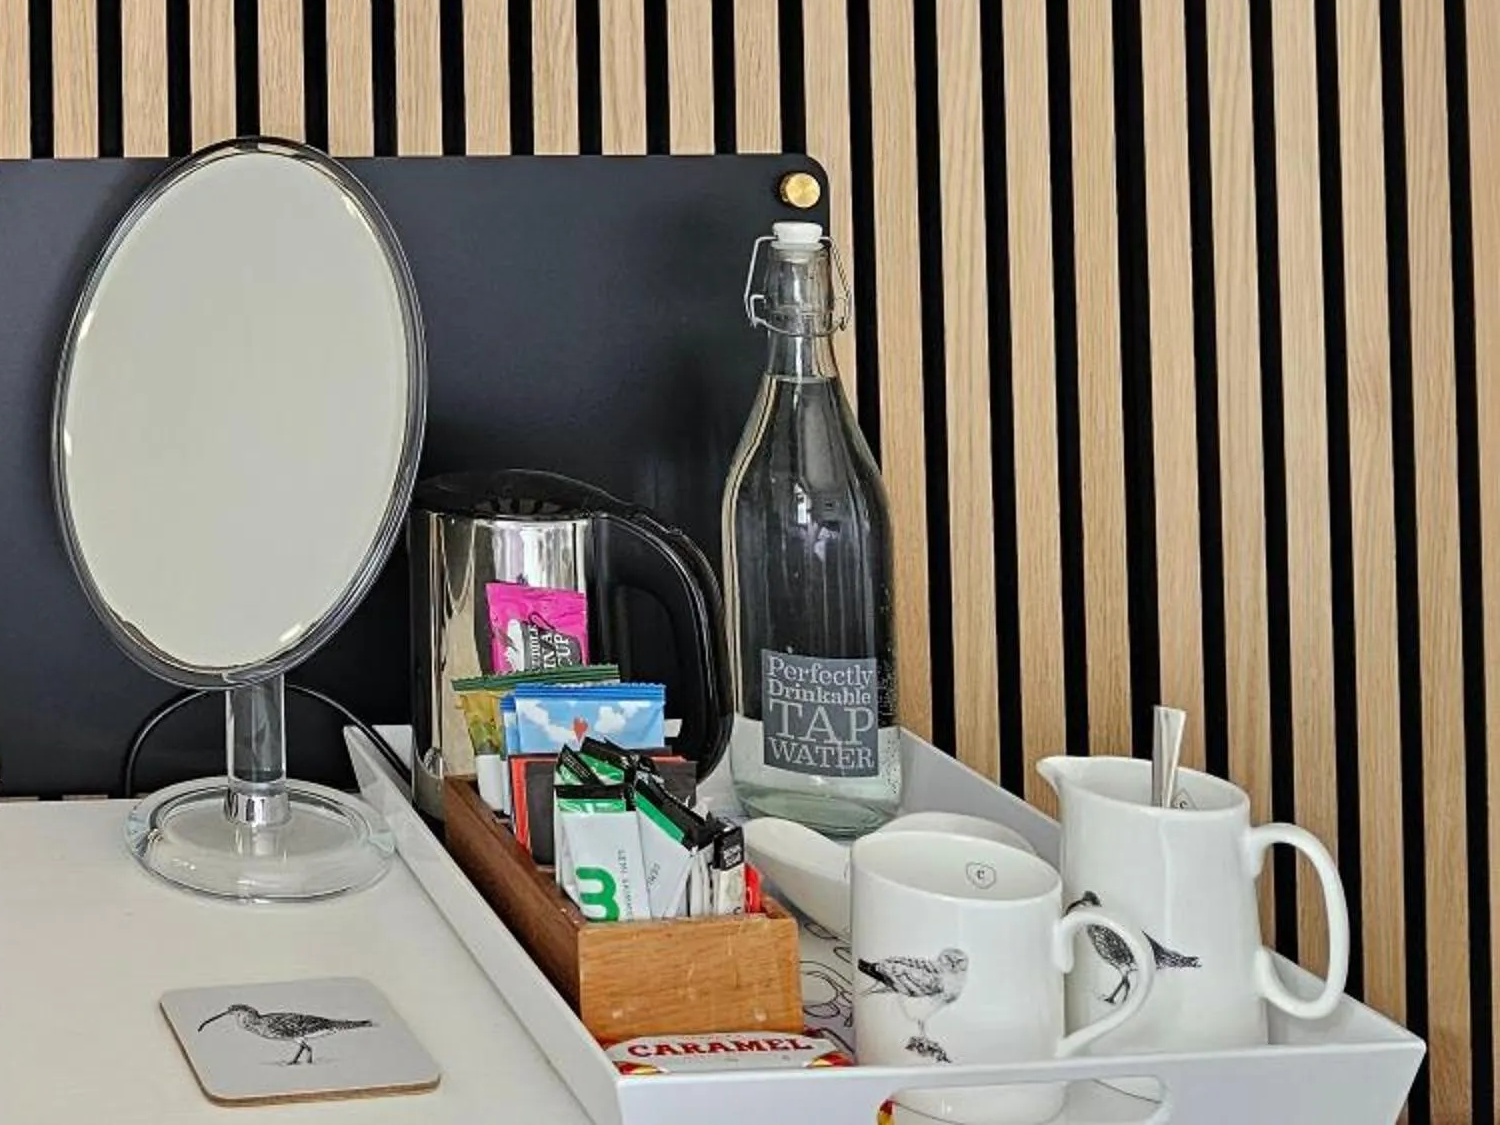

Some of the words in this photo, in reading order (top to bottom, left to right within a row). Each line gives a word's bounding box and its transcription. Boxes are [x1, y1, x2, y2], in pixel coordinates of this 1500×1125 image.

[767, 656, 873, 689] Perfectly
[767, 678, 871, 706] Drinkable
[769, 698, 875, 745] TAP
[768, 736, 875, 770] WATER
[627, 1037, 814, 1058] CARAMEL
